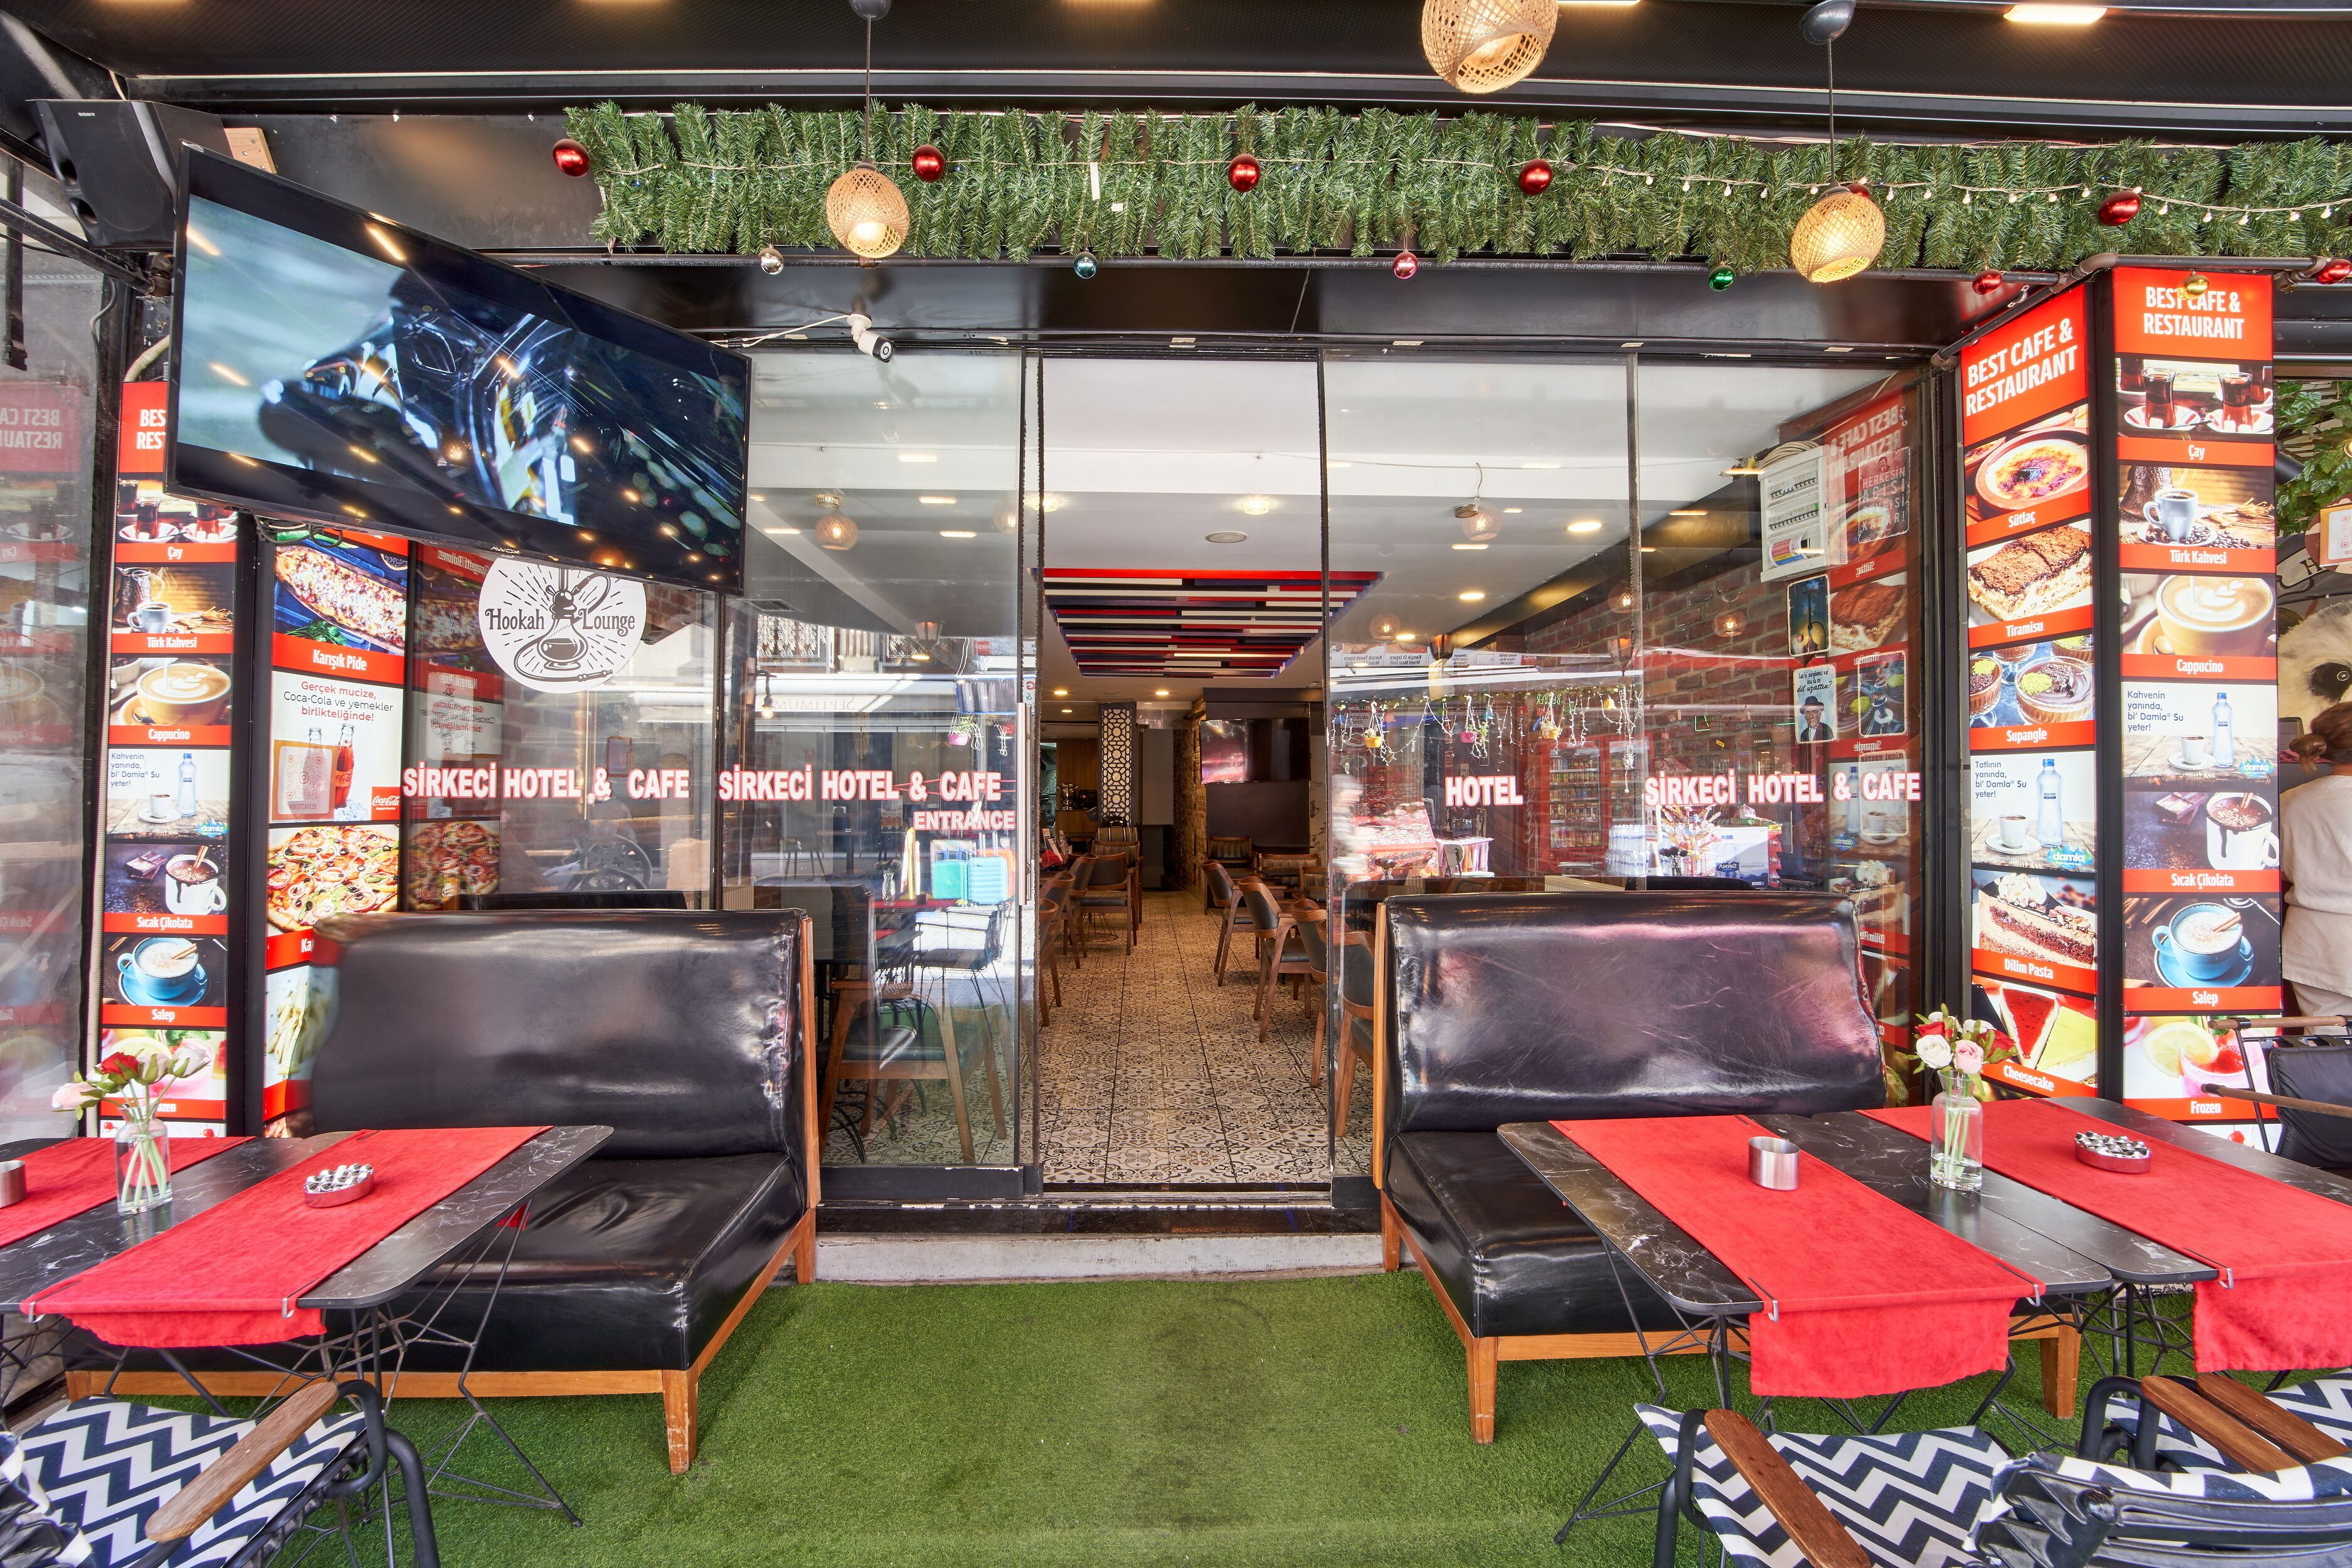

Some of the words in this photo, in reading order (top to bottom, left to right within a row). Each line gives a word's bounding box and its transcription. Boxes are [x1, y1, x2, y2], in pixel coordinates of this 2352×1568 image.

[2228, 292, 2241, 313] &
[2143, 313, 2245, 339] RESTAURANT
[1968, 348, 2008, 388] BEST
[2010, 324, 2056, 366] CAFE
[2058, 317, 2074, 344] &
[1966, 344, 2077, 416] RESTAURANT
[140, 409, 167, 427] BES
[2188, 444, 2205, 460] Çay
[2008, 511, 2037, 528] Sütlaç
[167, 546, 183, 560] Çay
[490, 546, 520, 554] AWOX
[2169, 549, 2191, 563] Türk
[2191, 550, 2227, 564] Kahvesi
[484, 608, 545, 630] Hookah
[578, 608, 635, 637] Lounge
[2005, 621, 2045, 637] Tiramisu
[147, 637, 166, 648] Türk
[166, 637, 198, 648] Kahvesi
[312, 649, 346, 670] Karışık
[346, 655, 368, 671] Pide
[2176, 659, 2224, 675] Cappucino
[301, 681, 336, 694] Gerçek
[339, 688, 376, 700] mucize,
[1796, 684, 1806, 693] dil
[2127, 690, 2166, 699] Kahvenin
[283, 691, 332, 706] Coca-Cola
[334, 698, 346, 707] ve
[348, 701, 394, 712] yemekler
[2127, 701, 2163, 711] yanında,
[301, 706, 374, 721] birlikteliğinde!
[2173, 712, 2183, 721] Su
[148, 728, 191, 742] Cappucino
[2006, 728, 2048, 744] Supangle
[2127, 723, 2151, 733] yeter!
[110, 761, 142, 770] yanında,
[403, 760, 497, 799] SİRKECİ
[502, 768, 582, 799] HOTEL
[592, 766, 613, 798] &
[627, 768, 690, 800] CAFE
[718, 763, 813, 801] SİRKECİ
[821, 770, 900, 801] HOTEL
[908, 770, 928, 802] &
[940, 770, 1002, 802] CAFE
[1975, 770, 2007, 779] yanında,
[110, 780, 130, 788] yeter!
[1444, 775, 1524, 807] HOTEL
[1645, 768, 1737, 806] SİRKECİ
[1747, 773, 1825, 803] HOTEL
[1833, 771, 1851, 801] &
[1862, 771, 1921, 802] CAFE
[2016, 780, 2026, 788] Su
[1975, 790, 1996, 799] yeter!
[913, 810, 1016, 831] ENTRANCE
[2052, 852, 2086, 862] damla
[2171, 872, 2196, 886] Sıcak
[2196, 872, 2234, 889] Çikolata
[137, 916, 160, 928] Sıcak
[160, 916, 193, 931] Çikolata
[2004, 958, 2028, 974] Dilim
[2028, 962, 2054, 979] Pasta
[2192, 991, 2218, 1007] Salep
[151, 1009, 176, 1023] Salep
[2003, 1064, 2055, 1091] Cheesecake
[157, 1103, 176, 1113] ozen
[2190, 1101, 2222, 1114] Frozen
